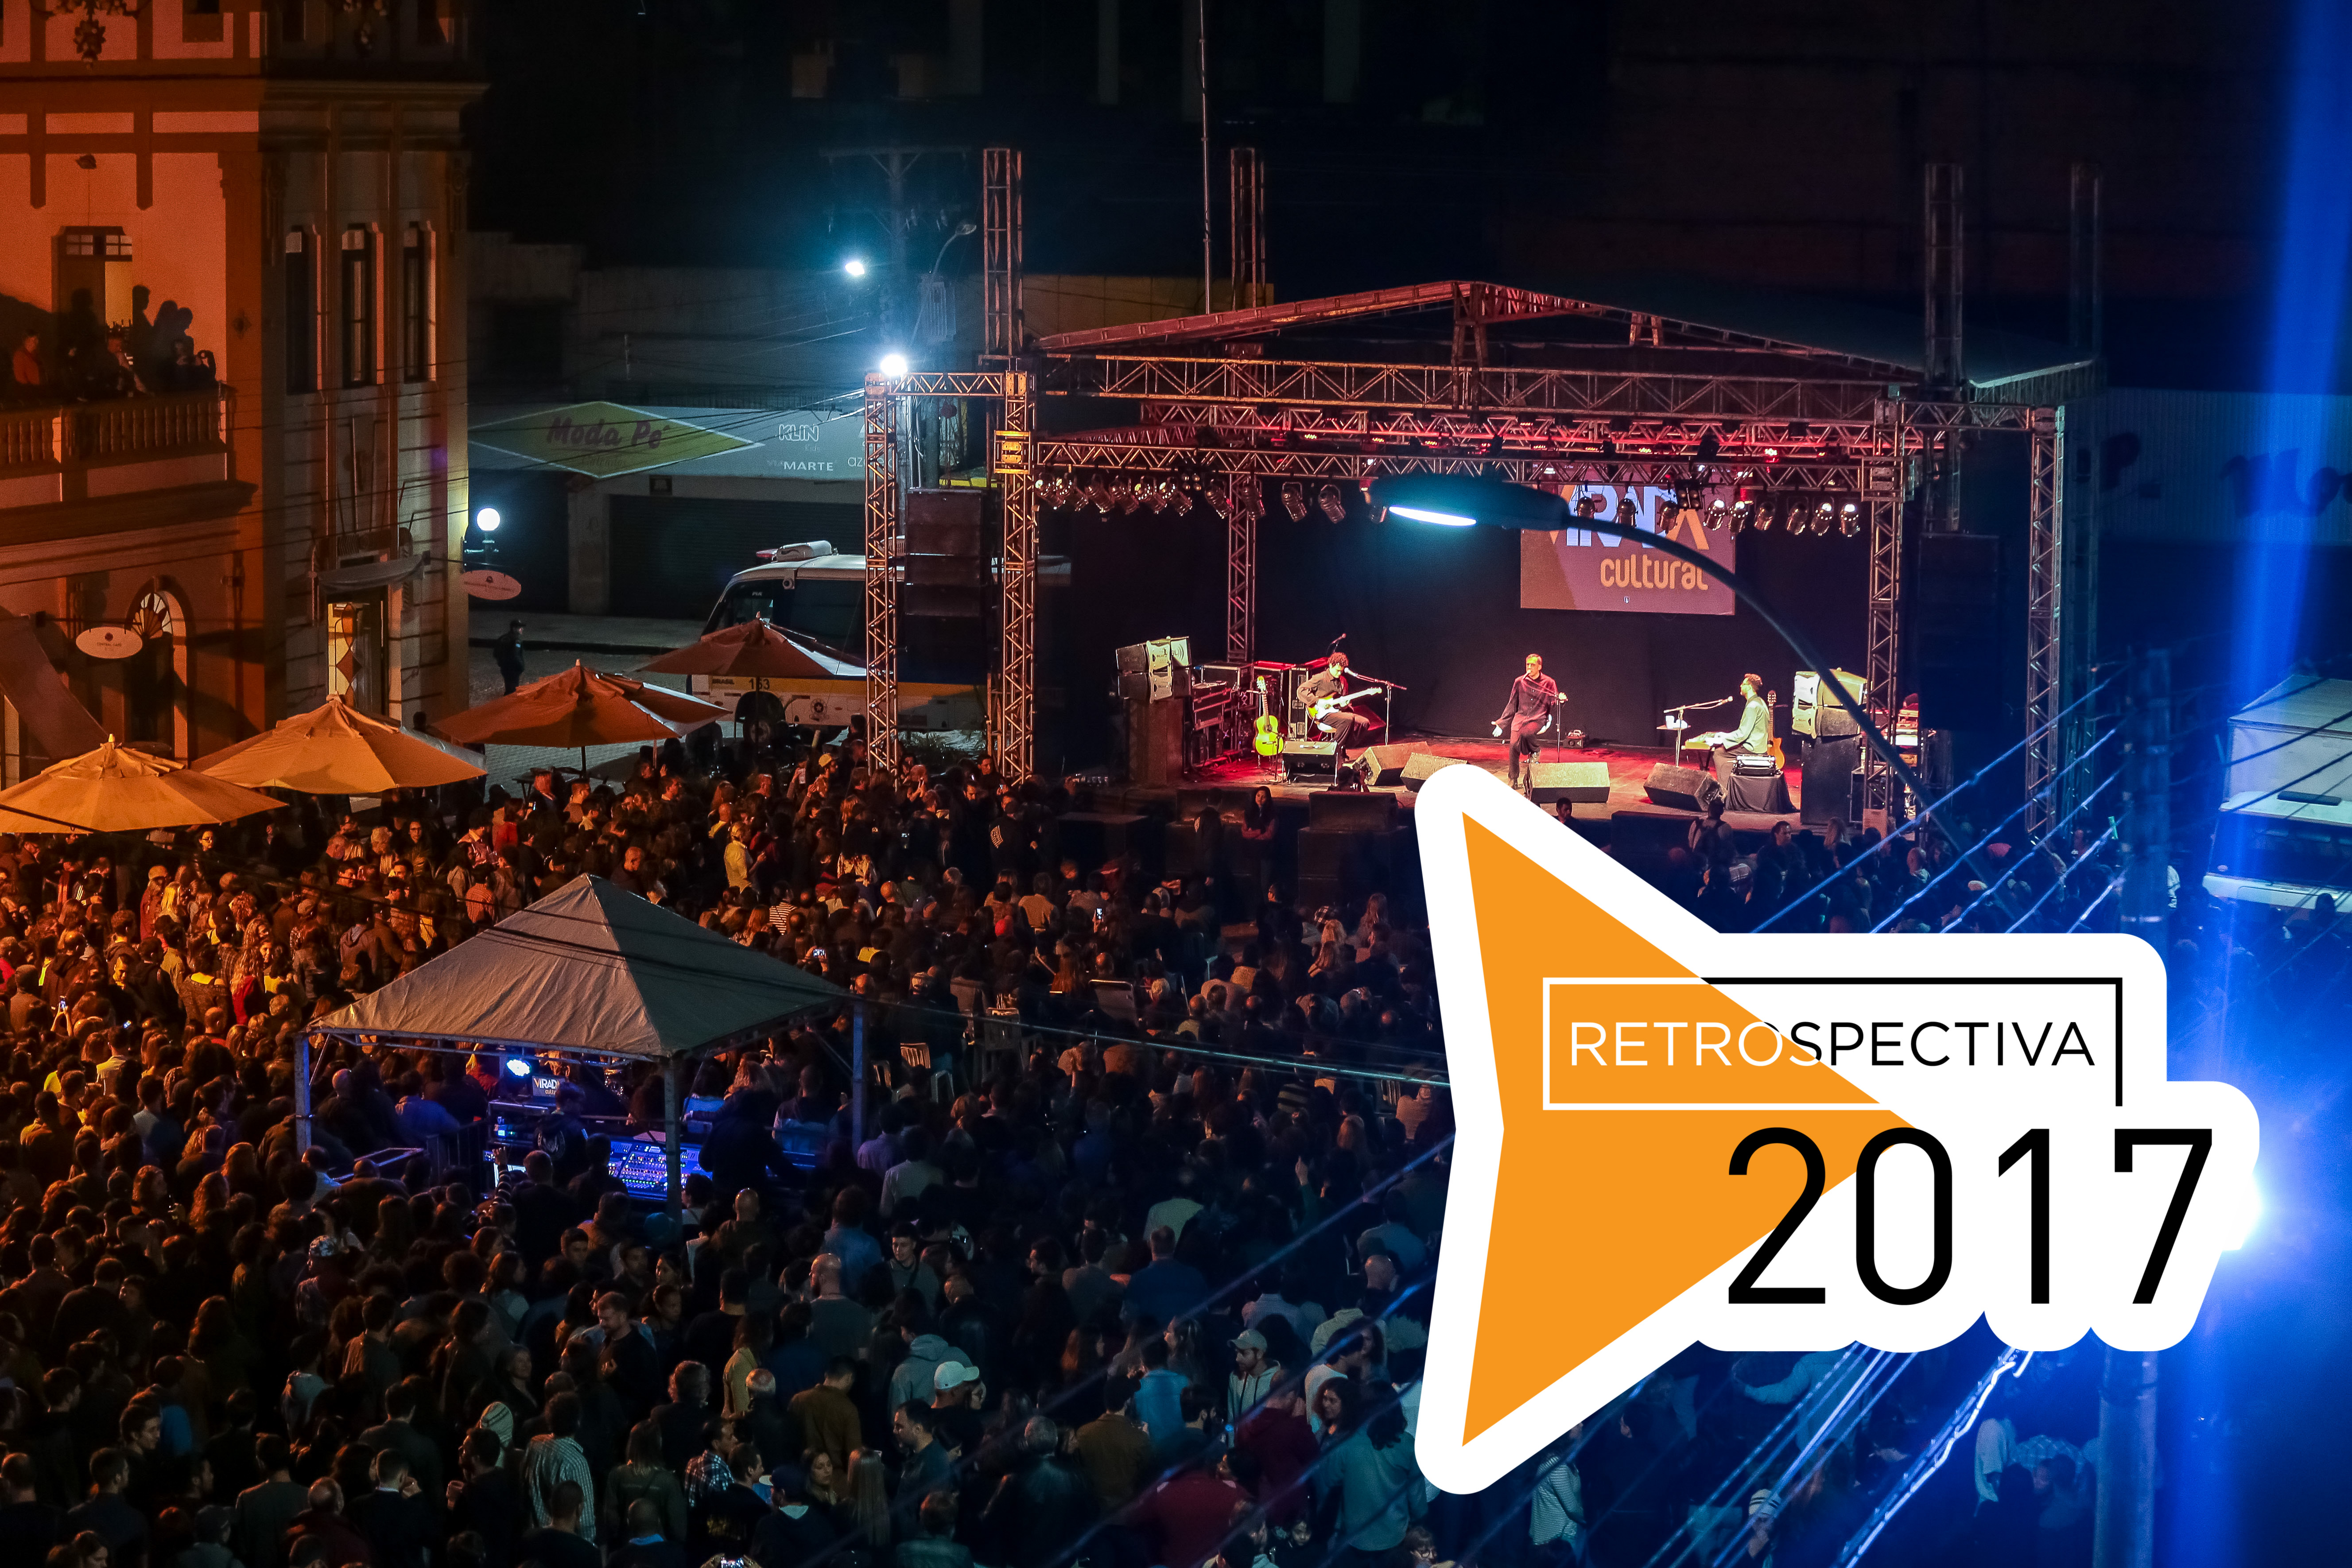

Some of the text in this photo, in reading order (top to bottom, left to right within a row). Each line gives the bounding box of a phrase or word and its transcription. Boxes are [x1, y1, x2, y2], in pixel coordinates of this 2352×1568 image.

[547, 416, 622, 446] Moda
[779, 424, 819, 442] KLIN
[784, 461, 834, 471] MARTE
[1600, 554, 1708, 590] cultural
